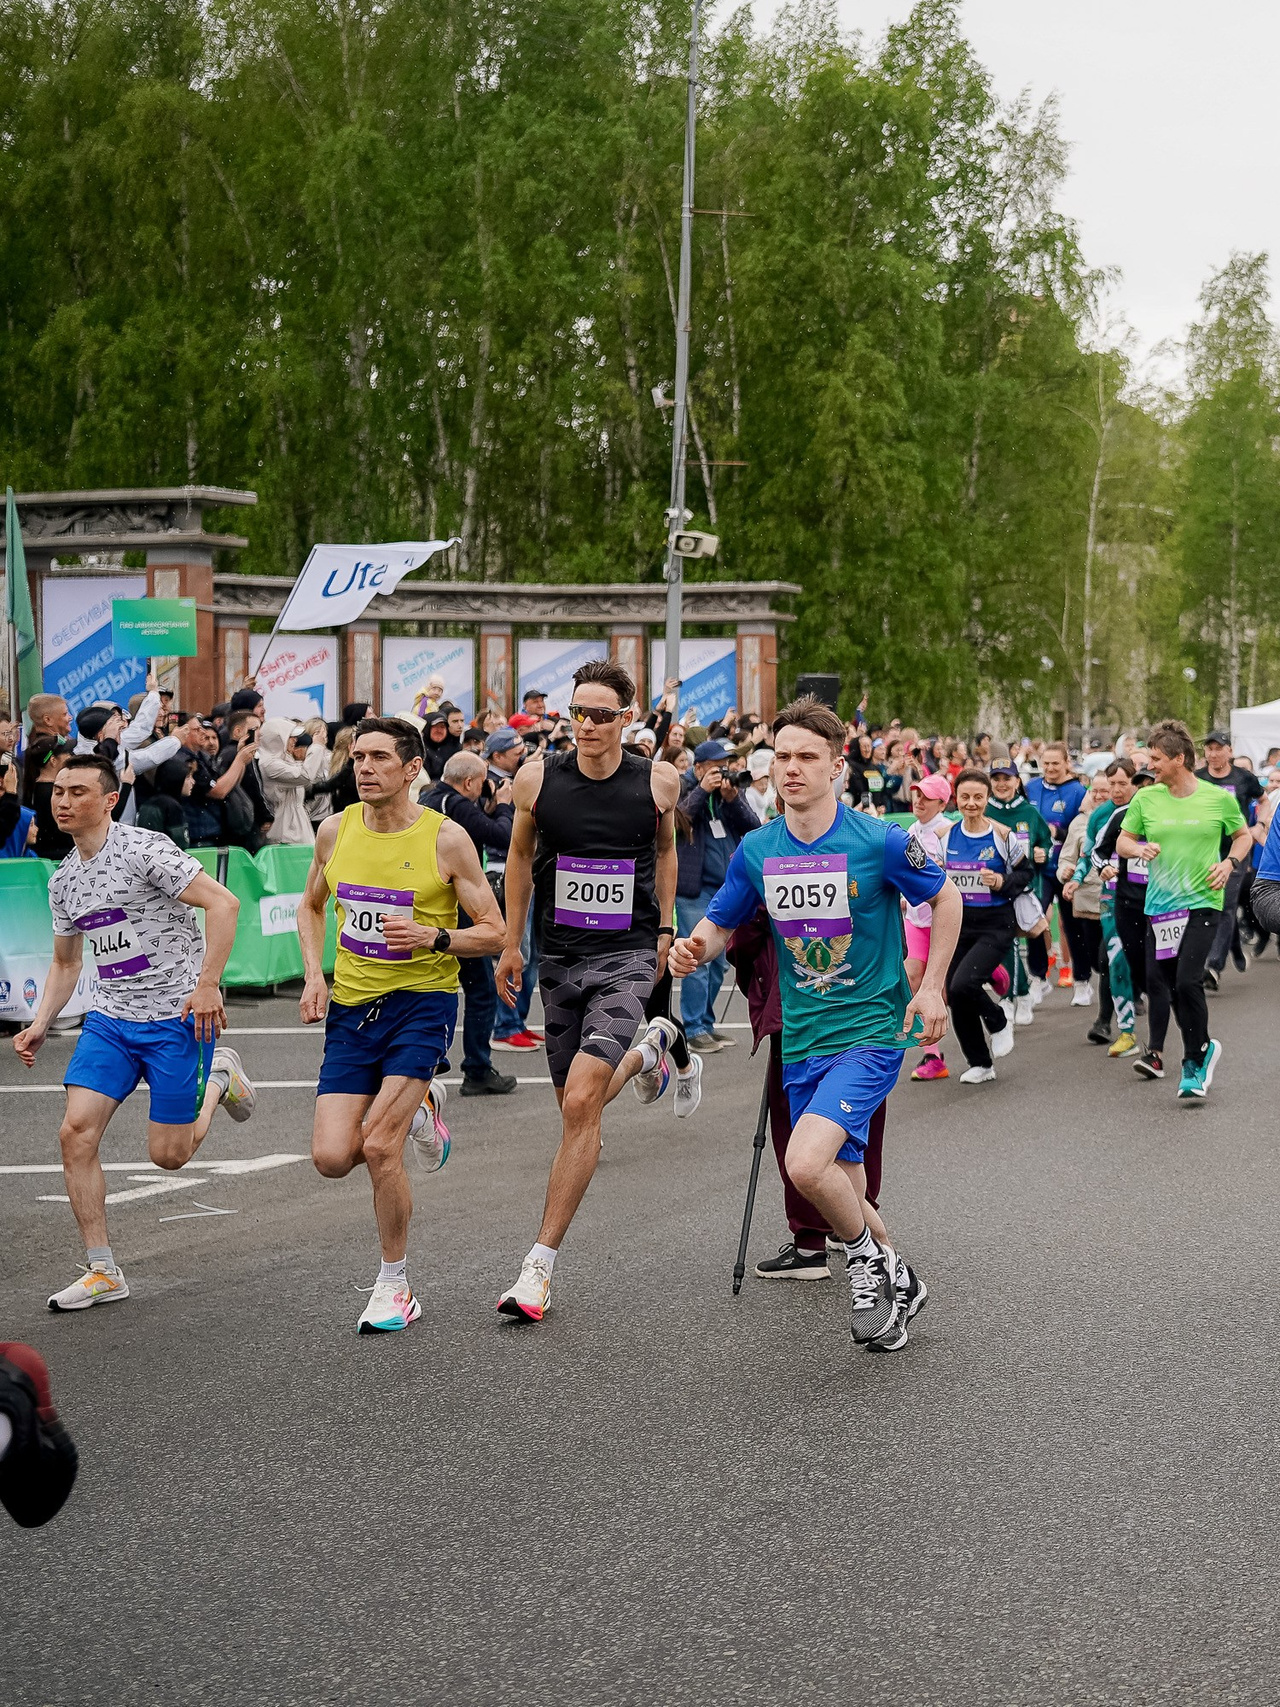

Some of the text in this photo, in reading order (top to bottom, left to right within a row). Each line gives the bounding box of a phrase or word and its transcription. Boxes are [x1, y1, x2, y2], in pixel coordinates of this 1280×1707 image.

[57, 644, 115, 696] ДВИЖЕ
[66, 656, 145, 719] ЕРВЫХ
[566, 881, 625, 904] 2005
[775, 883, 837, 909] 2059
[350, 907, 388, 934] 205
[89, 930, 132, 957] 2444
